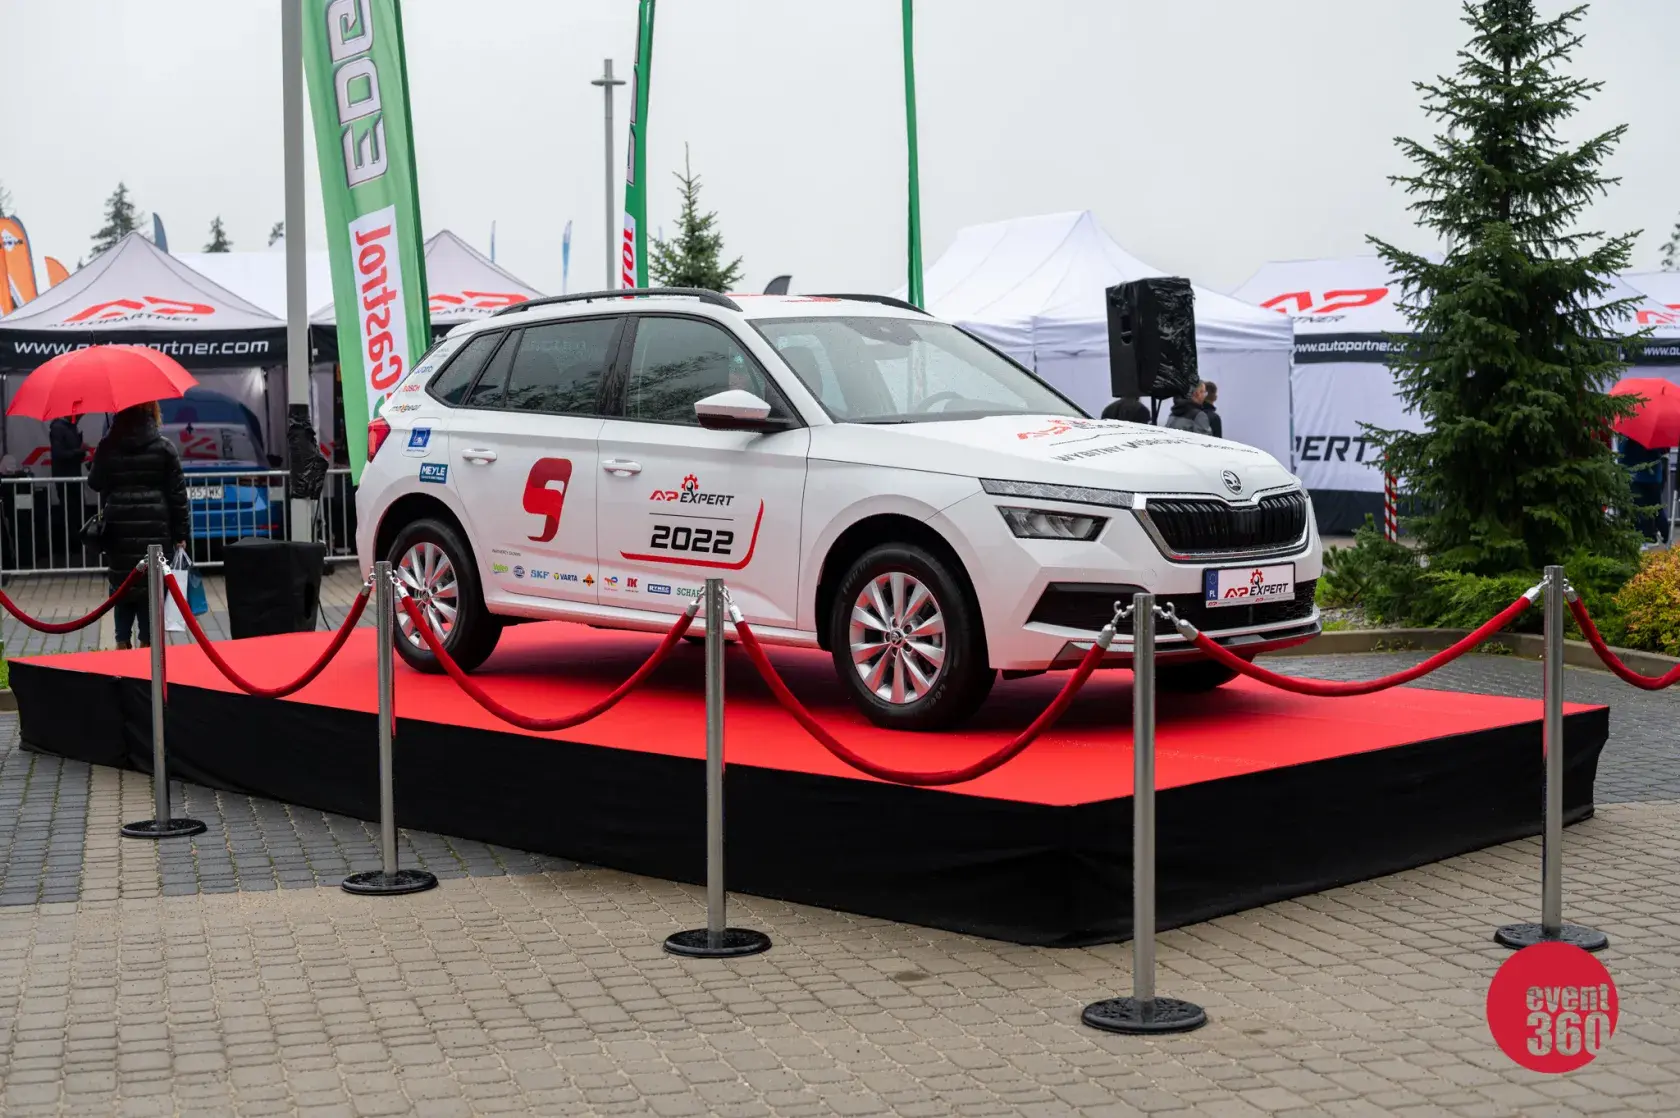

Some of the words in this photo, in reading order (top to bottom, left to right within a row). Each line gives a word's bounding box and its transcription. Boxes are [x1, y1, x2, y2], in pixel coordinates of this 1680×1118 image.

[421, 465, 446, 477] MEYLE
[649, 490, 679, 501] AP
[680, 492, 734, 506] EXPERT
[650, 525, 734, 555] 2022
[530, 569, 549, 579] SKF
[560, 573, 578, 582] VARTA
[1224, 587, 1249, 598] AP
[1249, 583, 1288, 596] EXPERT
